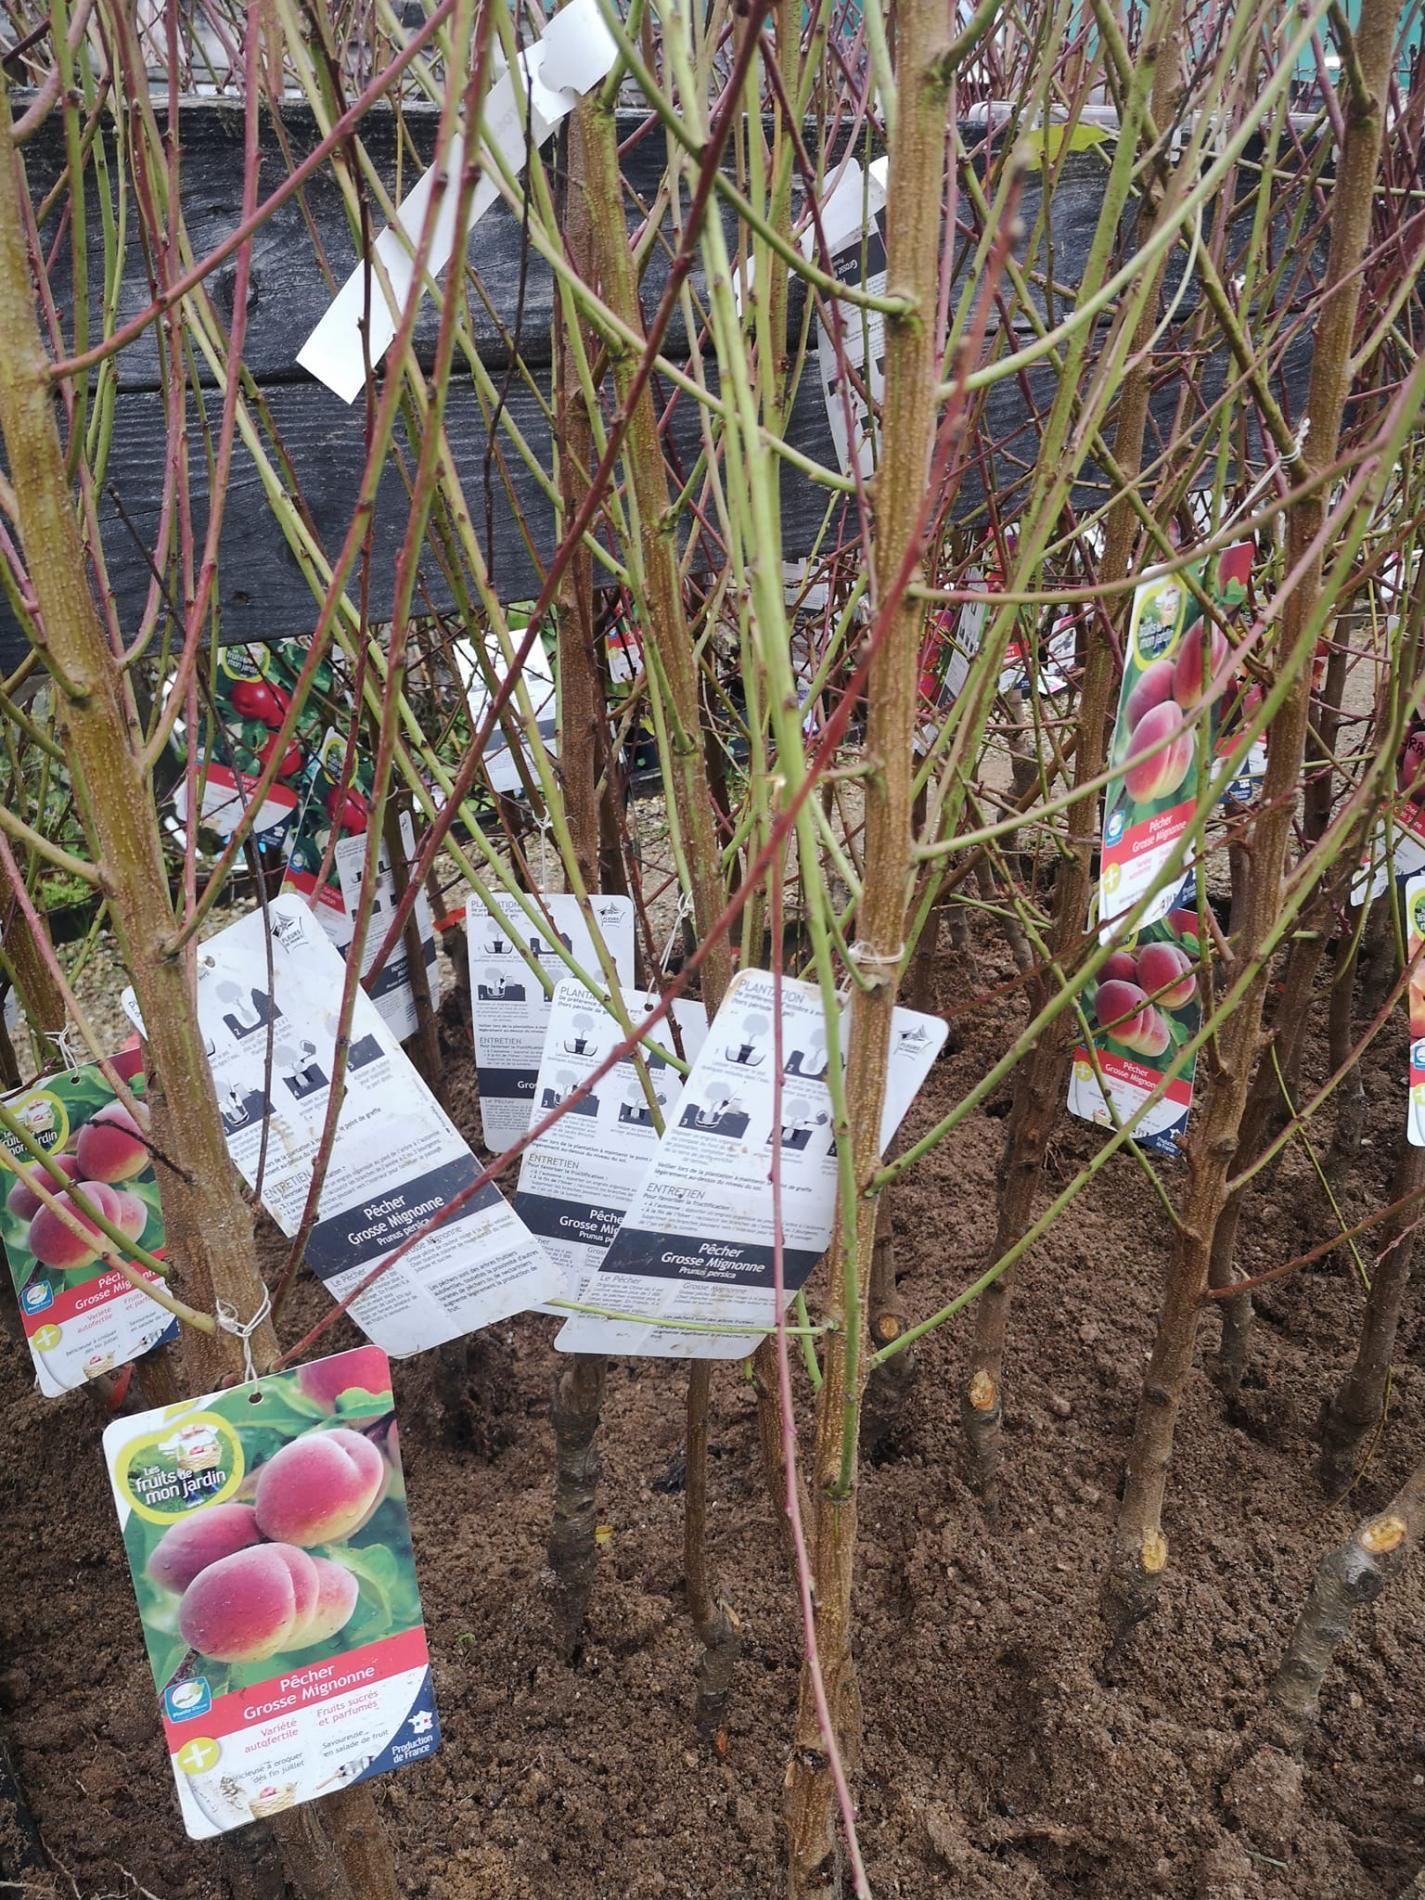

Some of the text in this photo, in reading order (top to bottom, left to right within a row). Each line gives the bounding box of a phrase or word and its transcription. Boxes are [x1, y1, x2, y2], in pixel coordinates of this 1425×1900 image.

[1148, 815, 1173, 833] Pêcher
[1132, 836, 1156, 852] Grosse
[560, 986, 596, 1001] PLANTA
[740, 978, 805, 1004] PLANTTION
[480, 1037, 522, 1045] ENTRETIEN
[787, 1064, 794, 1072] 2
[1105, 1063, 1130, 1079] Grosse
[1123, 1061, 1148, 1077] Pêcher
[517, 1080, 536, 1089] Gro
[681, 1117, 688, 1126] 3
[37, 1131, 58, 1145] rdin
[528, 1153, 580, 1169] ENTRETIEN
[263, 1169, 312, 1200] ENTRETIEN
[646, 1182, 706, 1200] ENTRETIEN
[363, 1194, 406, 1221] Pêcher
[347, 1196, 445, 1246] Grosse Mignonne
[559, 1215, 598, 1231] Grosse
[589, 1209, 624, 1225] Pêche
[376, 1231, 403, 1247] Prunus
[579, 1230, 603, 1241] Prunus
[698, 1242, 745, 1258] Pêcher
[661, 1251, 766, 1273] Grosse Mignonne
[613, 1274, 642, 1284] Pêcher
[678, 1265, 737, 1280] Prunus persica
[682, 1281, 710, 1291] Grosse
[75, 1290, 111, 1311] Grosse
[135, 1468, 193, 1492] fruits de
[145, 1470, 227, 1505] mon jardin
[280, 1664, 335, 1692] Pêcher
[243, 1666, 375, 1720] Grosse Mignonne
[316, 1688, 379, 1718] Fruits sucrés
[318, 1700, 378, 1726] et parfumés
[260, 1717, 297, 1737] Variété
[244, 1728, 299, 1754] autofertile
[336, 1739, 359, 1753] salade
[360, 1736, 370, 1744] de
[372, 1729, 389, 1740] fruit
[392, 1733, 433, 1756] Production
[274, 1751, 303, 1767] croquer
[393, 1743, 430, 1764] de France
[269, 1768, 280, 1778] fin
[282, 1760, 304, 1776] juillet
